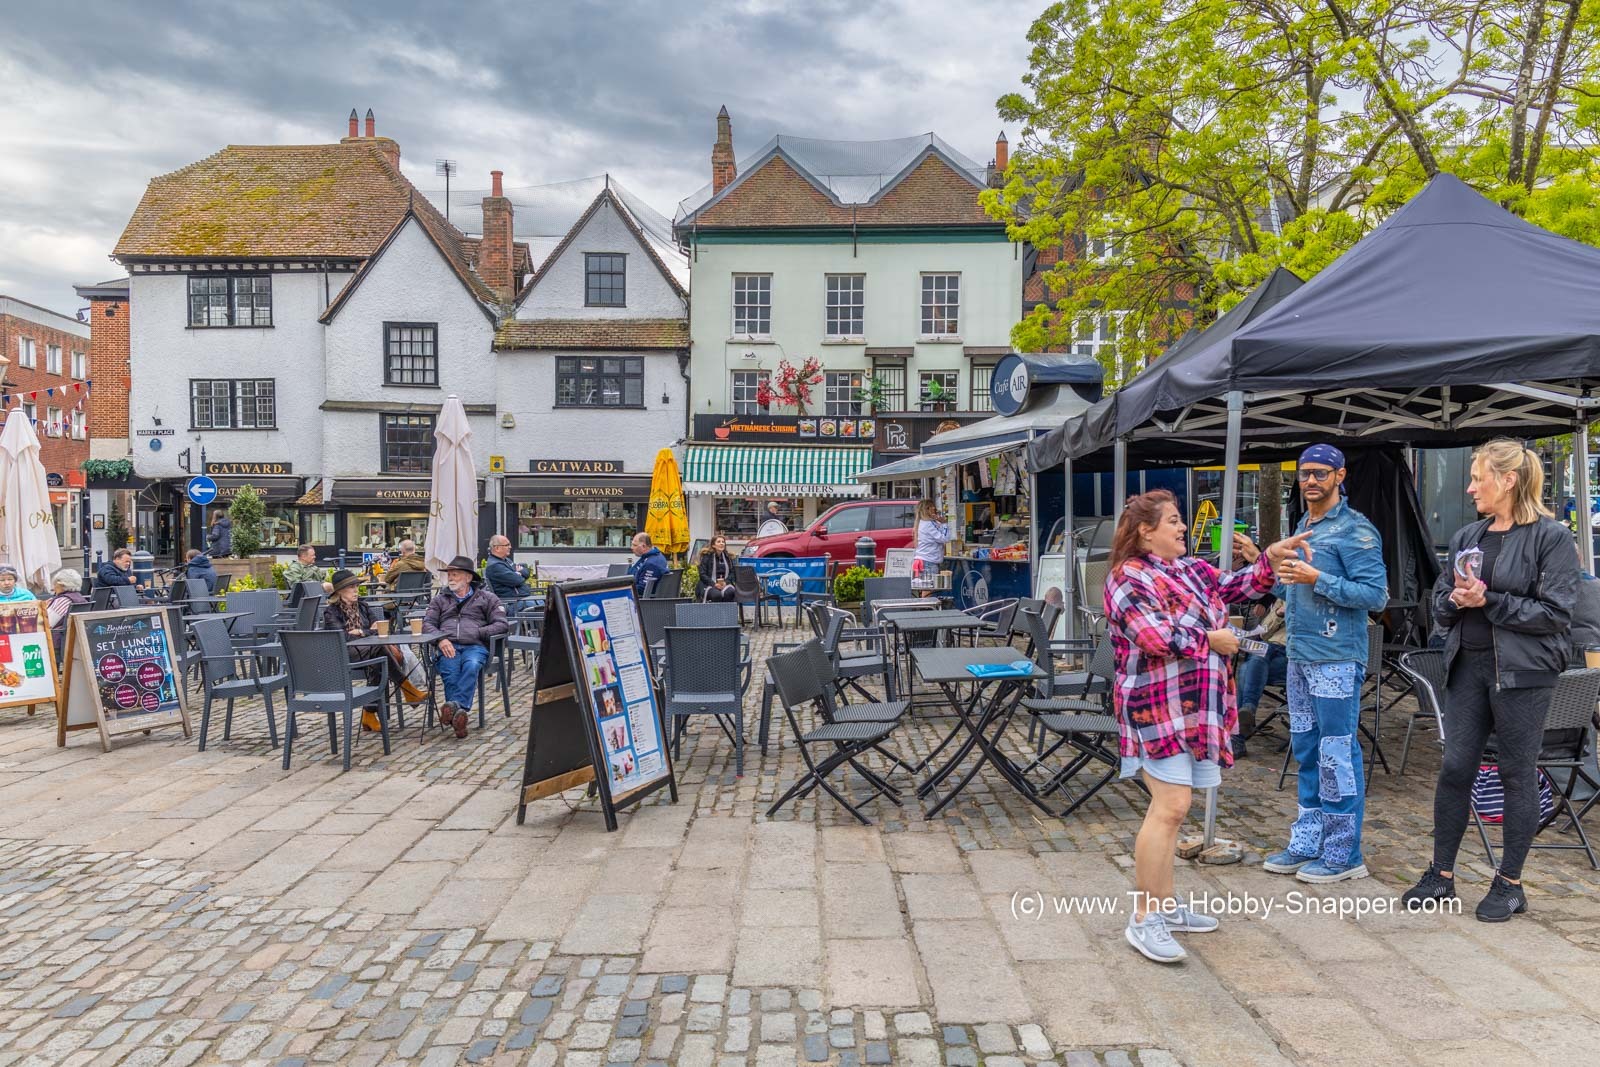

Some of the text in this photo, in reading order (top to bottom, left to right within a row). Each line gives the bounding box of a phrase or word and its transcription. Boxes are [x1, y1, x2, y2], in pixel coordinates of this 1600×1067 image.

[994, 375, 1027, 396] Café AIR
[730, 424, 798, 434] VIETNAMESE CUISINE
[537, 461, 618, 472] GATWARD.
[572, 487, 624, 496] GATWARDS
[718, 483, 834, 493] ALLINGHAM BUTCHERS
[96, 635, 160, 652] SET LUNCH
[127, 645, 160, 657] MENU
